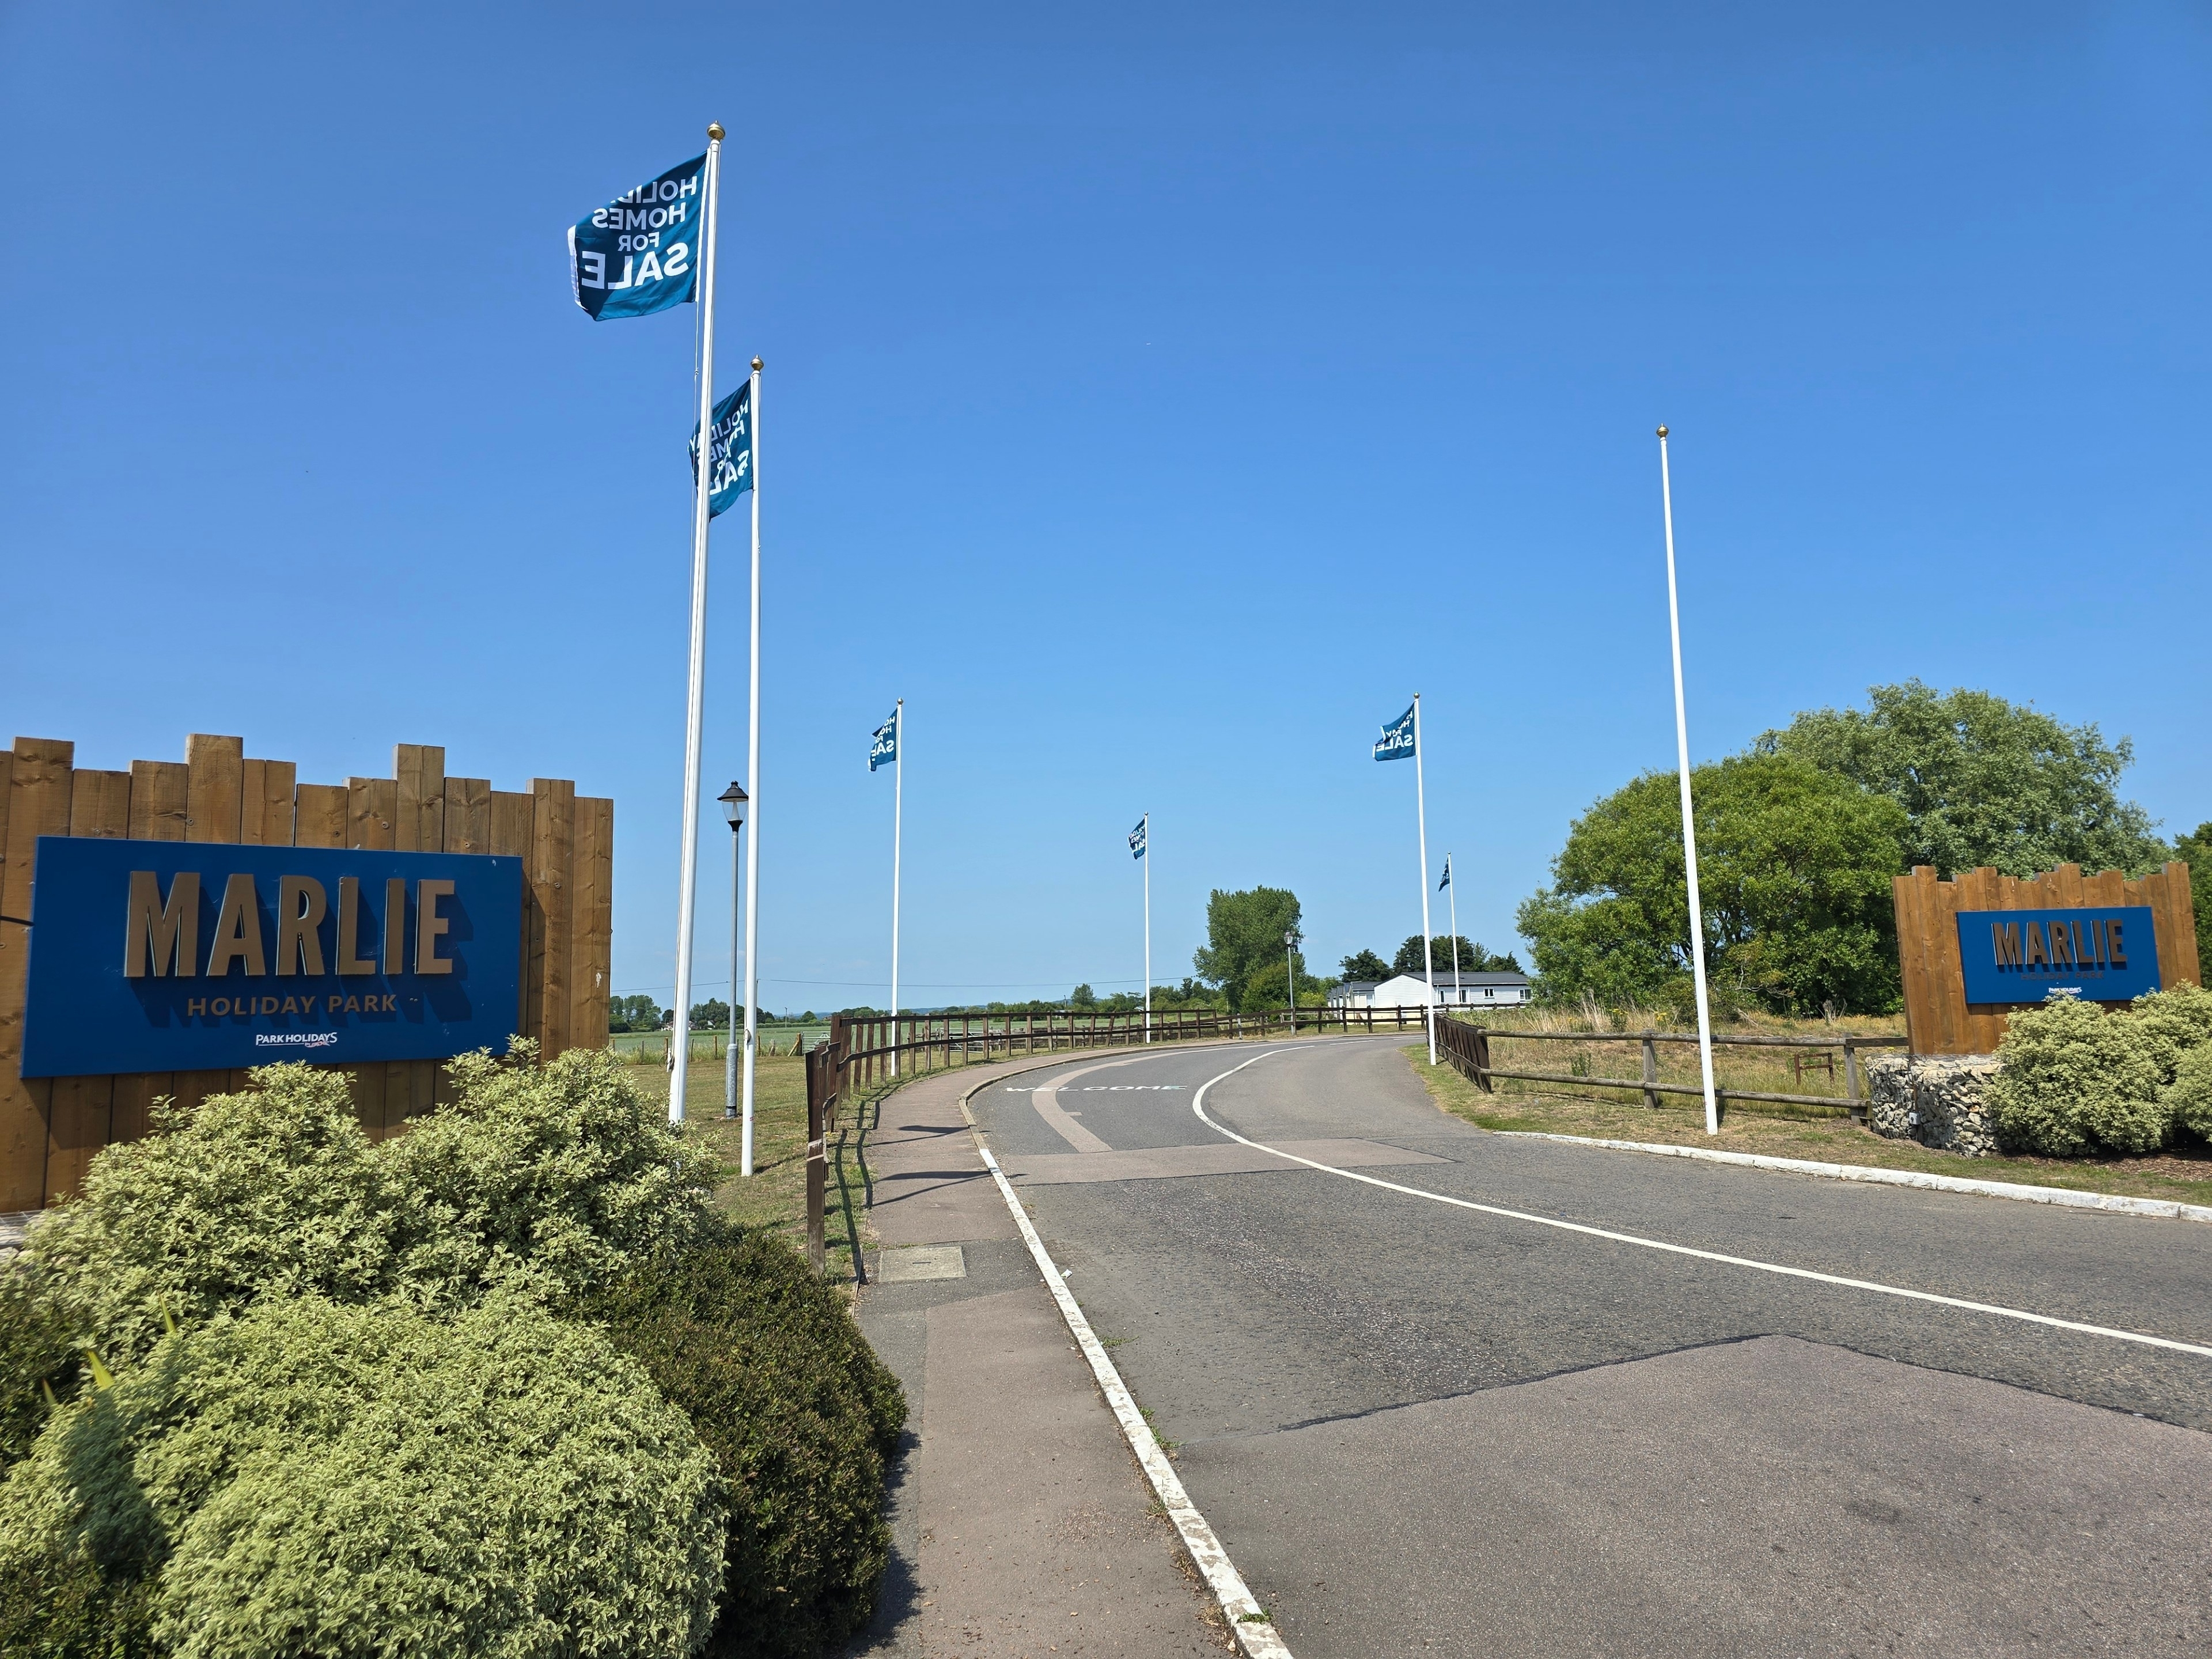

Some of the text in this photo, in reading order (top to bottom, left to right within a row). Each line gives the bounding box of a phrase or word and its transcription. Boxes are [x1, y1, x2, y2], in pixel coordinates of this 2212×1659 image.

[124, 870, 455, 978] MARLIE
[1991, 918, 2127, 966] MARLIE
[2020, 970, 2104, 980] HOLIDAY PARK
[188, 994, 397, 1017] HOLIDAY PARK
[256, 1032, 338, 1046] PARK HOLIDAYS
